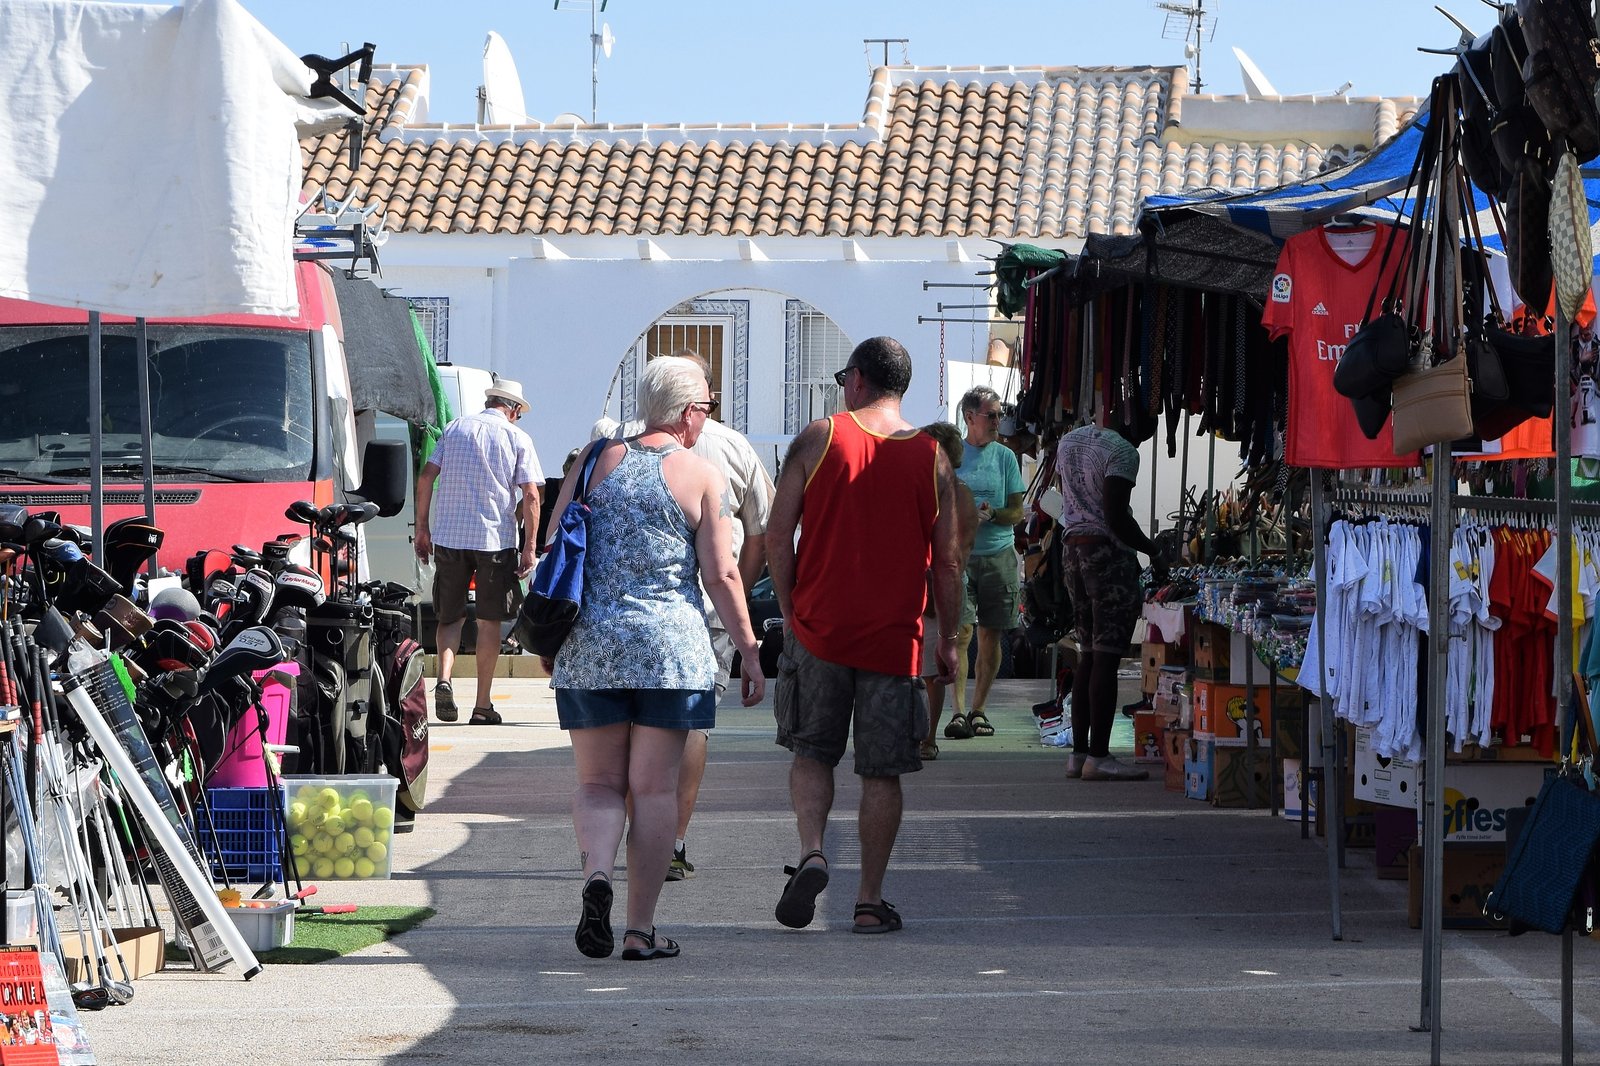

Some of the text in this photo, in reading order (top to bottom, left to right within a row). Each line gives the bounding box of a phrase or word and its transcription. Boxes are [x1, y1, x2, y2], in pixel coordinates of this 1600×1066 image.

[1317, 340, 1347, 361] Em
[282, 575, 317, 588] TaylorMade
[1443, 799, 1506, 839] yffes
[0, 964, 42, 977] CYCLOPEDIA
[0, 981, 48, 1007] ORMULA
